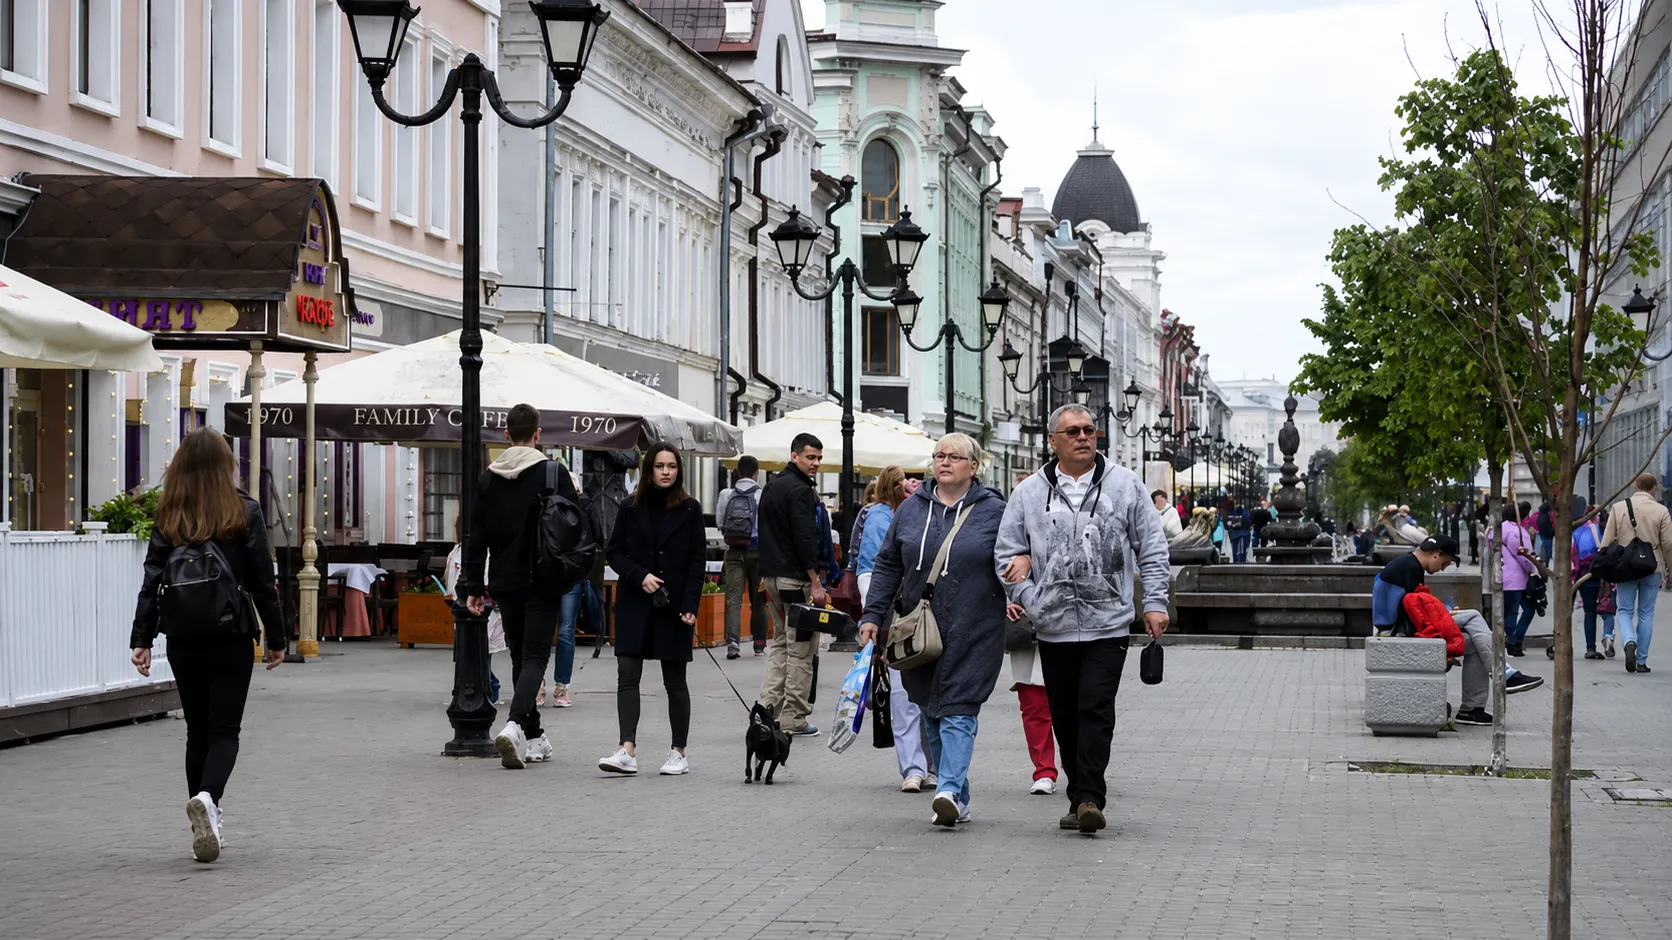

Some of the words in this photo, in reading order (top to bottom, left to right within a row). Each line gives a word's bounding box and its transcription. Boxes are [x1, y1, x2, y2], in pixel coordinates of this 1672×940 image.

[244, 407, 293, 425] 1970
[353, 408, 441, 426] FAMILY
[447, 409, 508, 429] CFE
[570, 415, 617, 435] 1970
